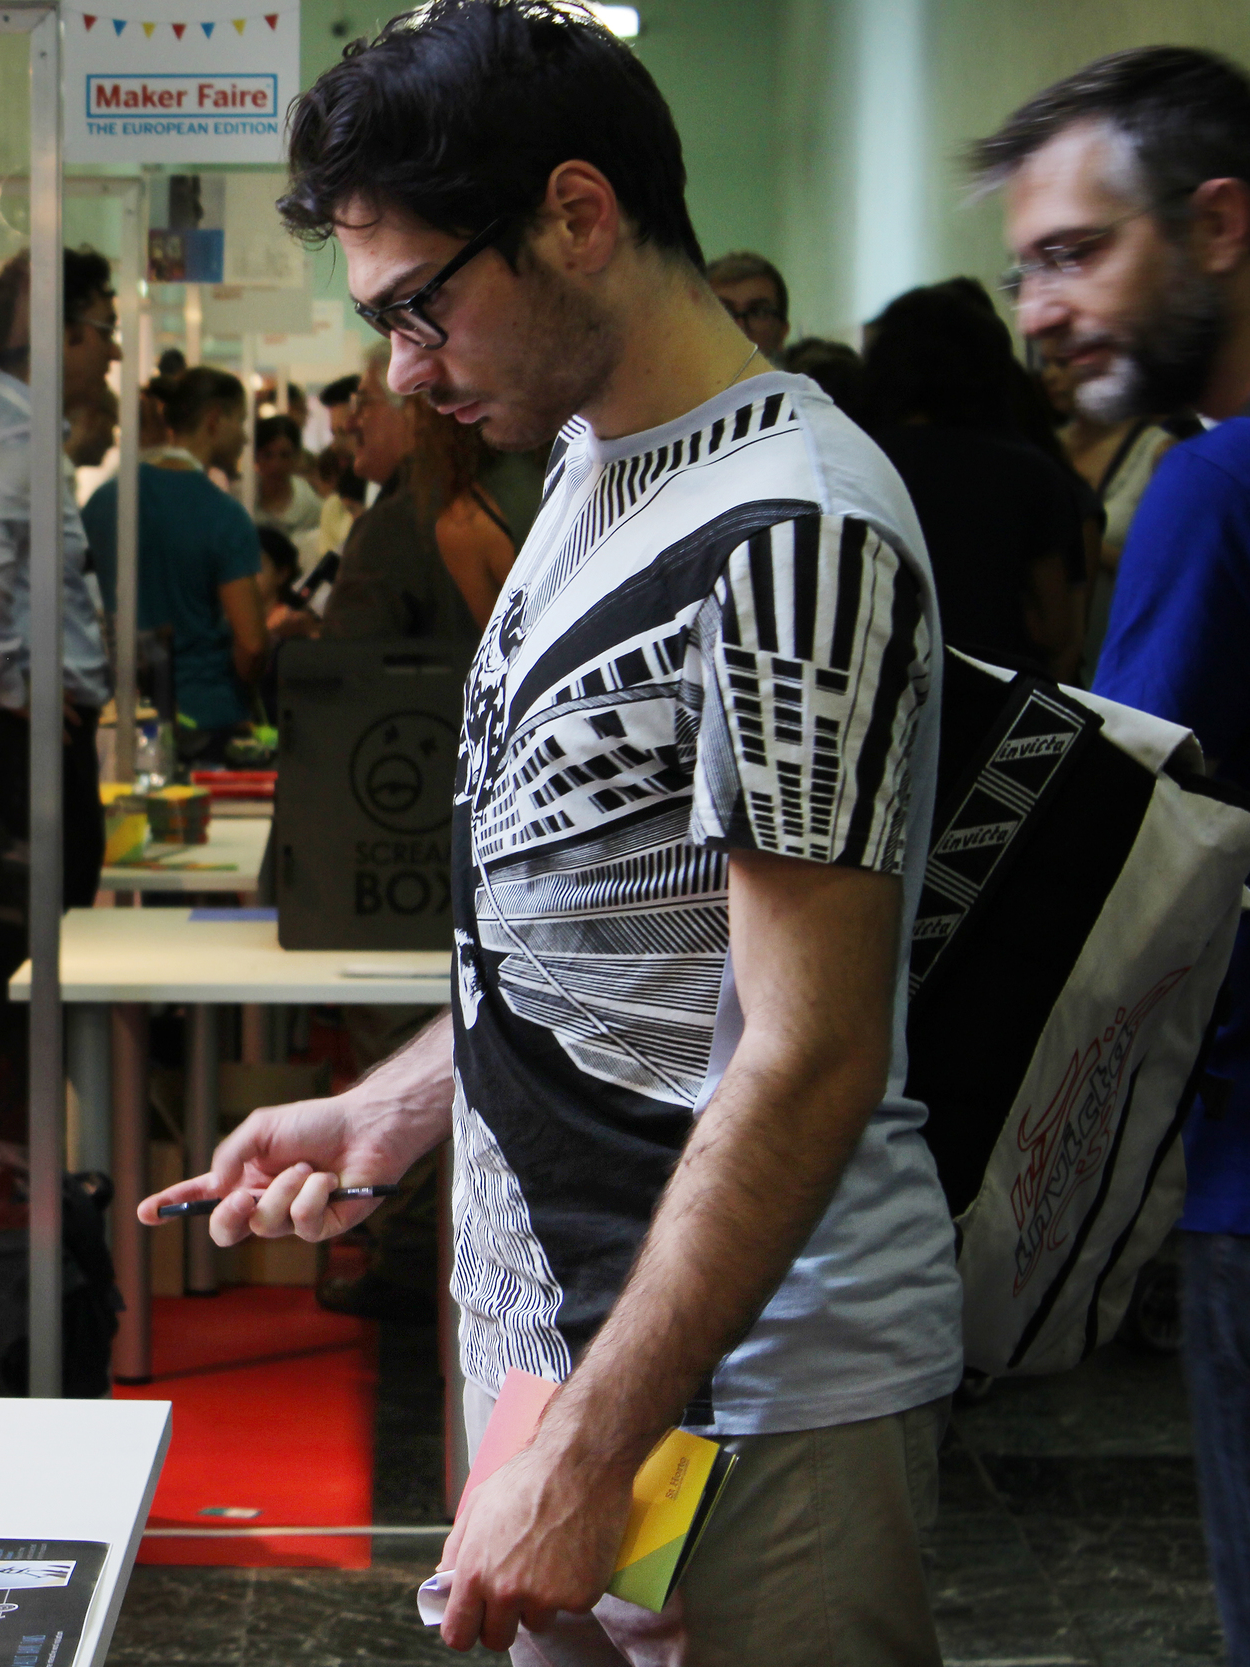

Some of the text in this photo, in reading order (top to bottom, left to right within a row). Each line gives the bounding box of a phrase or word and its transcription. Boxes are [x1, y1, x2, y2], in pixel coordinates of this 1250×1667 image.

[96, 83, 268, 108] Maker Faire
[86, 121, 278, 135] THE EUROPEAN EDITION
[1000, 736, 1066, 760] invicta
[944, 826, 1009, 849] invicta
[355, 840, 452, 864] SCREA
[912, 919, 951, 937] icta
